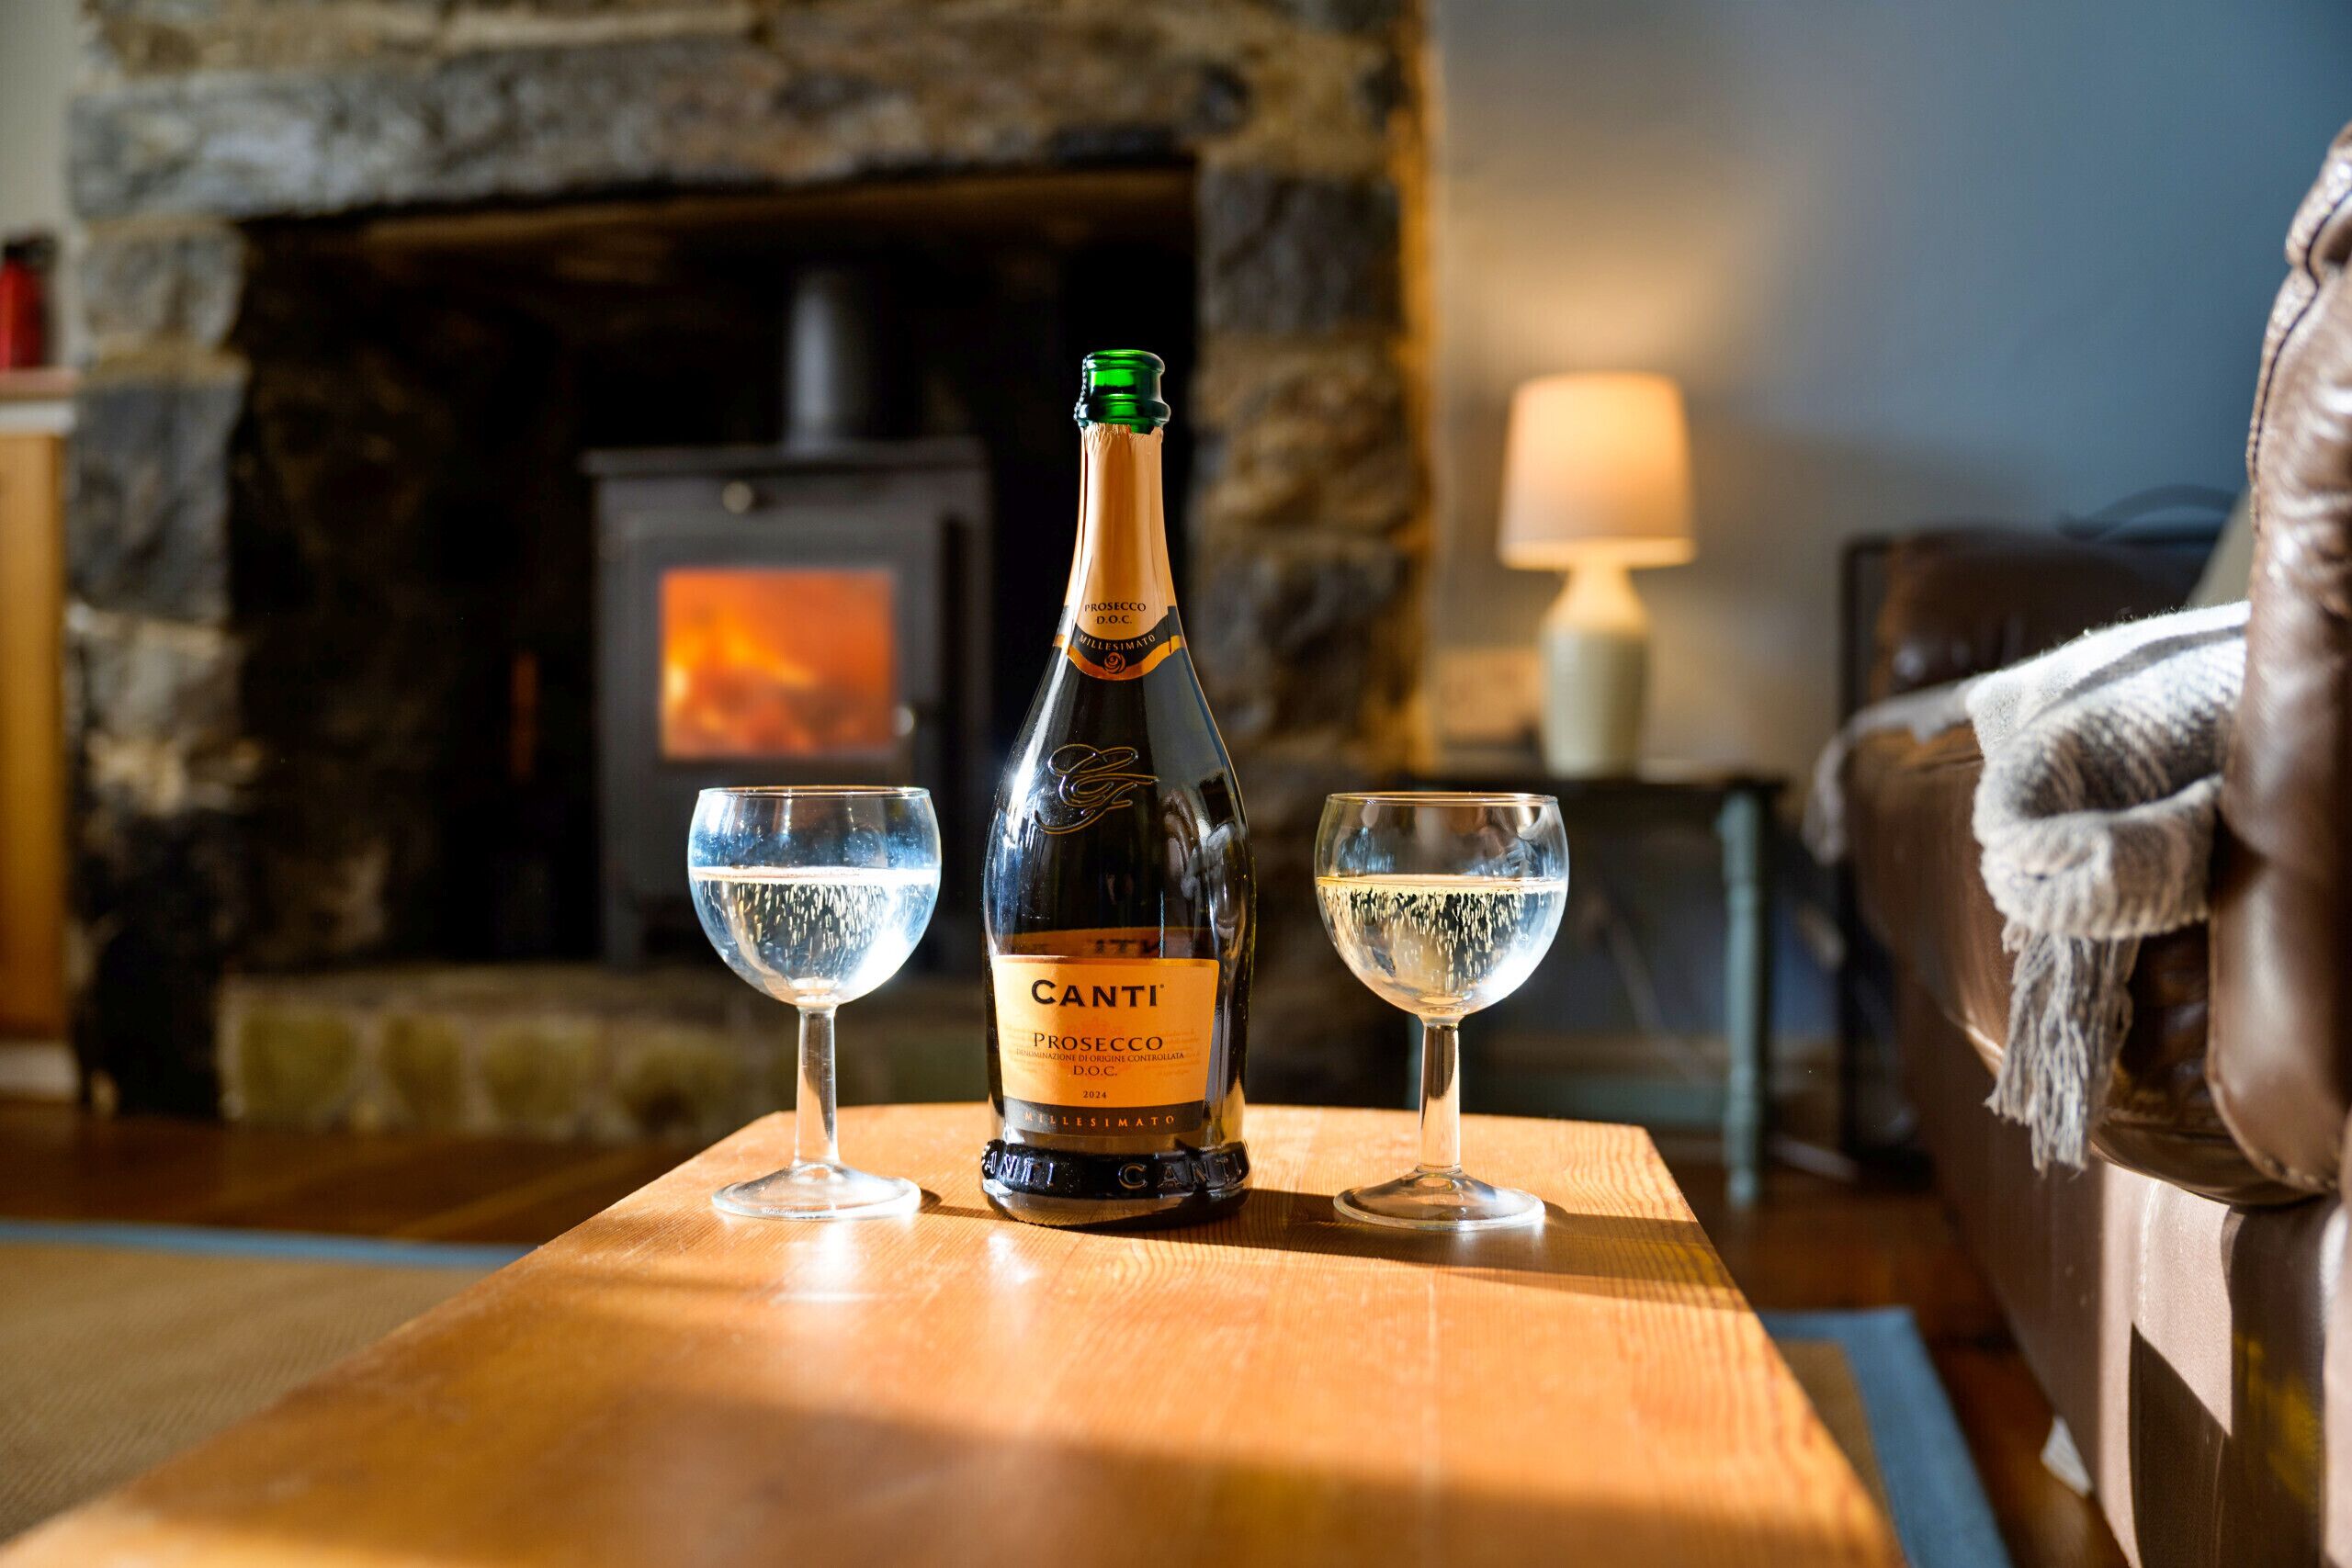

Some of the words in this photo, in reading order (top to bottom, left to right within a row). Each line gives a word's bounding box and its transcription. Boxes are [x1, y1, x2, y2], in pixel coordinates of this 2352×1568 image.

[1084, 602, 1147, 613] PROSECCO
[1096, 615, 1133, 625] D.O.C.
[1079, 634, 1156, 651] MILLESIMATO
[1031, 979, 1158, 1008] CANTI
[1034, 1032, 1163, 1052] PROSECCO
[1016, 1048, 1077, 1062] DENOMINAZIONE
[1079, 1055, 1088, 1063] DI
[1090, 1055, 1125, 1063] ORIGINE
[1127, 1052, 1184, 1063] CONTROLLATA
[1073, 1066, 1117, 1077] D.O.C.
[1082, 1090, 1107, 1099] 2024
[1024, 1111, 1175, 1128] MILLESIMATO
[984, 1150, 1055, 1188] ANTI
[1118, 1152, 1243, 1190] CANTI
